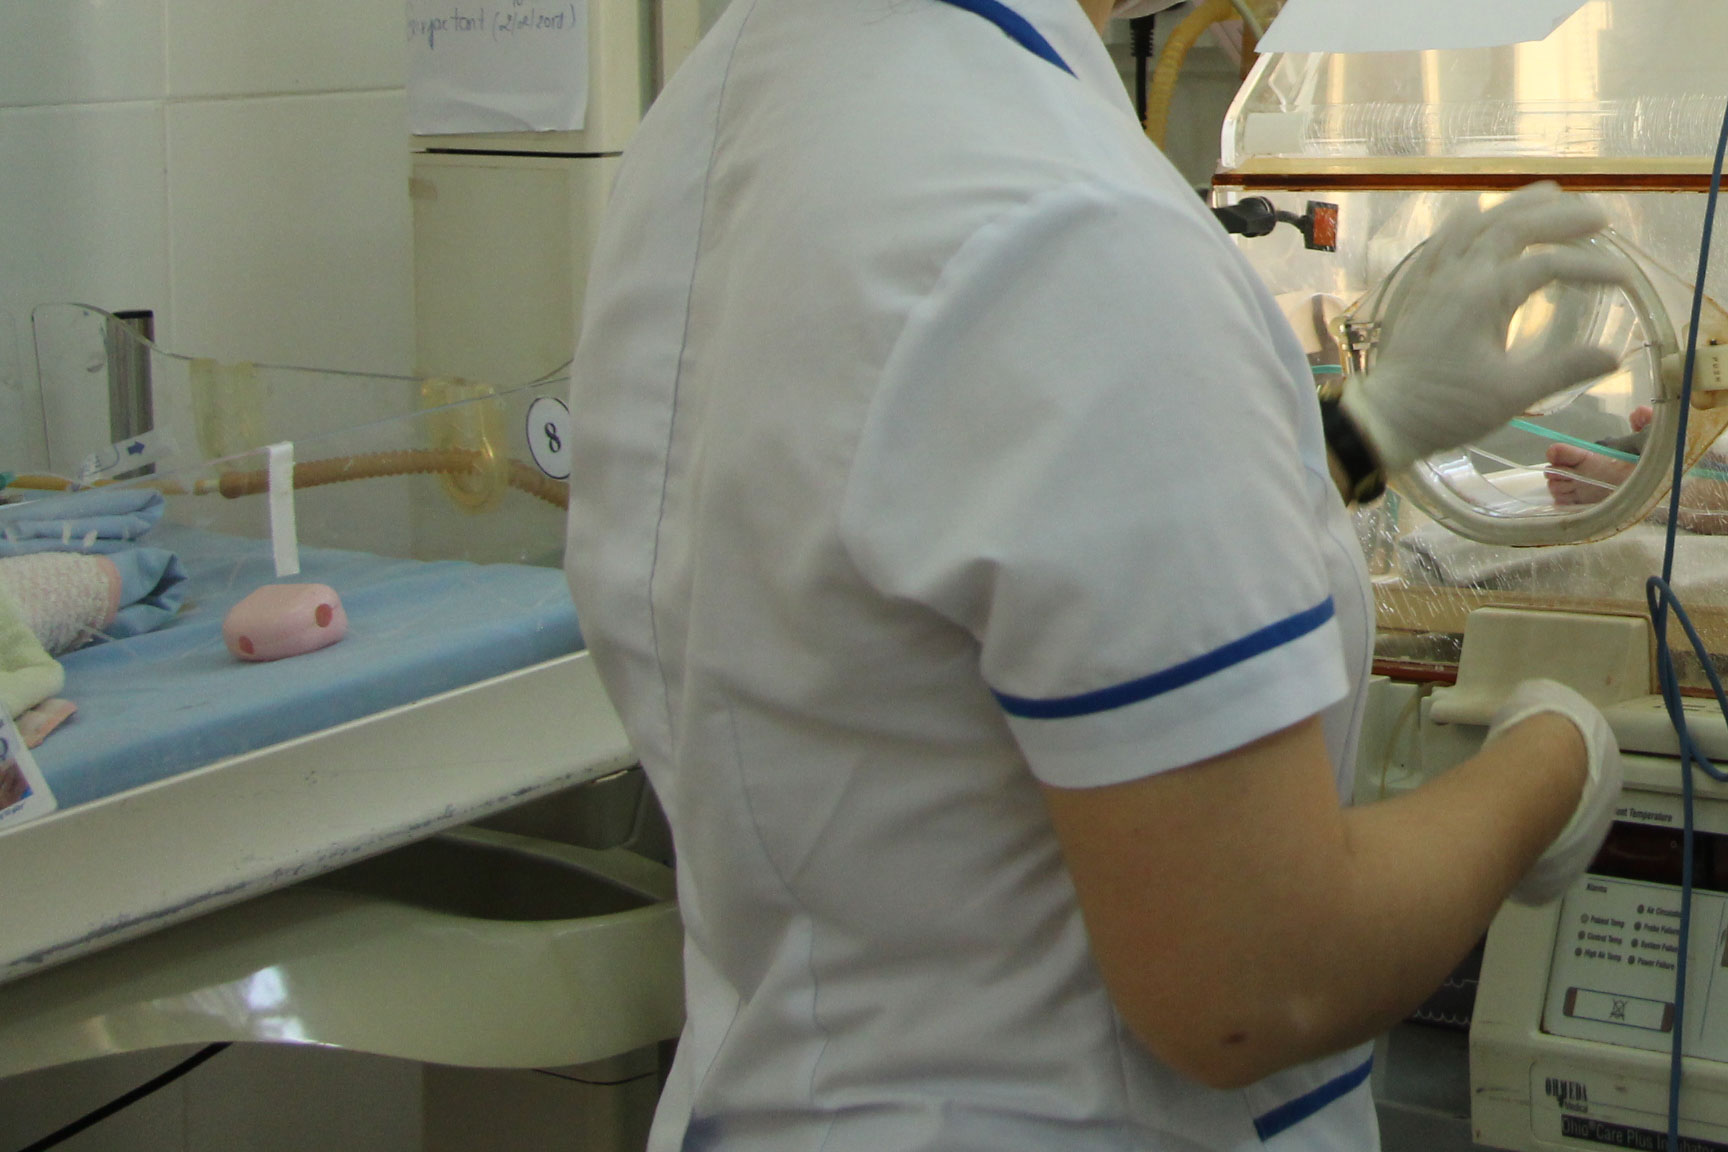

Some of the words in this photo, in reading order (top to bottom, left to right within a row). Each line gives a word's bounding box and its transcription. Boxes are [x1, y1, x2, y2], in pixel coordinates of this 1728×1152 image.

[1629, 807, 1673, 823] Temperature
[1545, 1077, 1588, 1102] OHMEDA
[1596, 1122, 1624, 1144] Care
[1626, 1129, 1653, 1148] Plus
